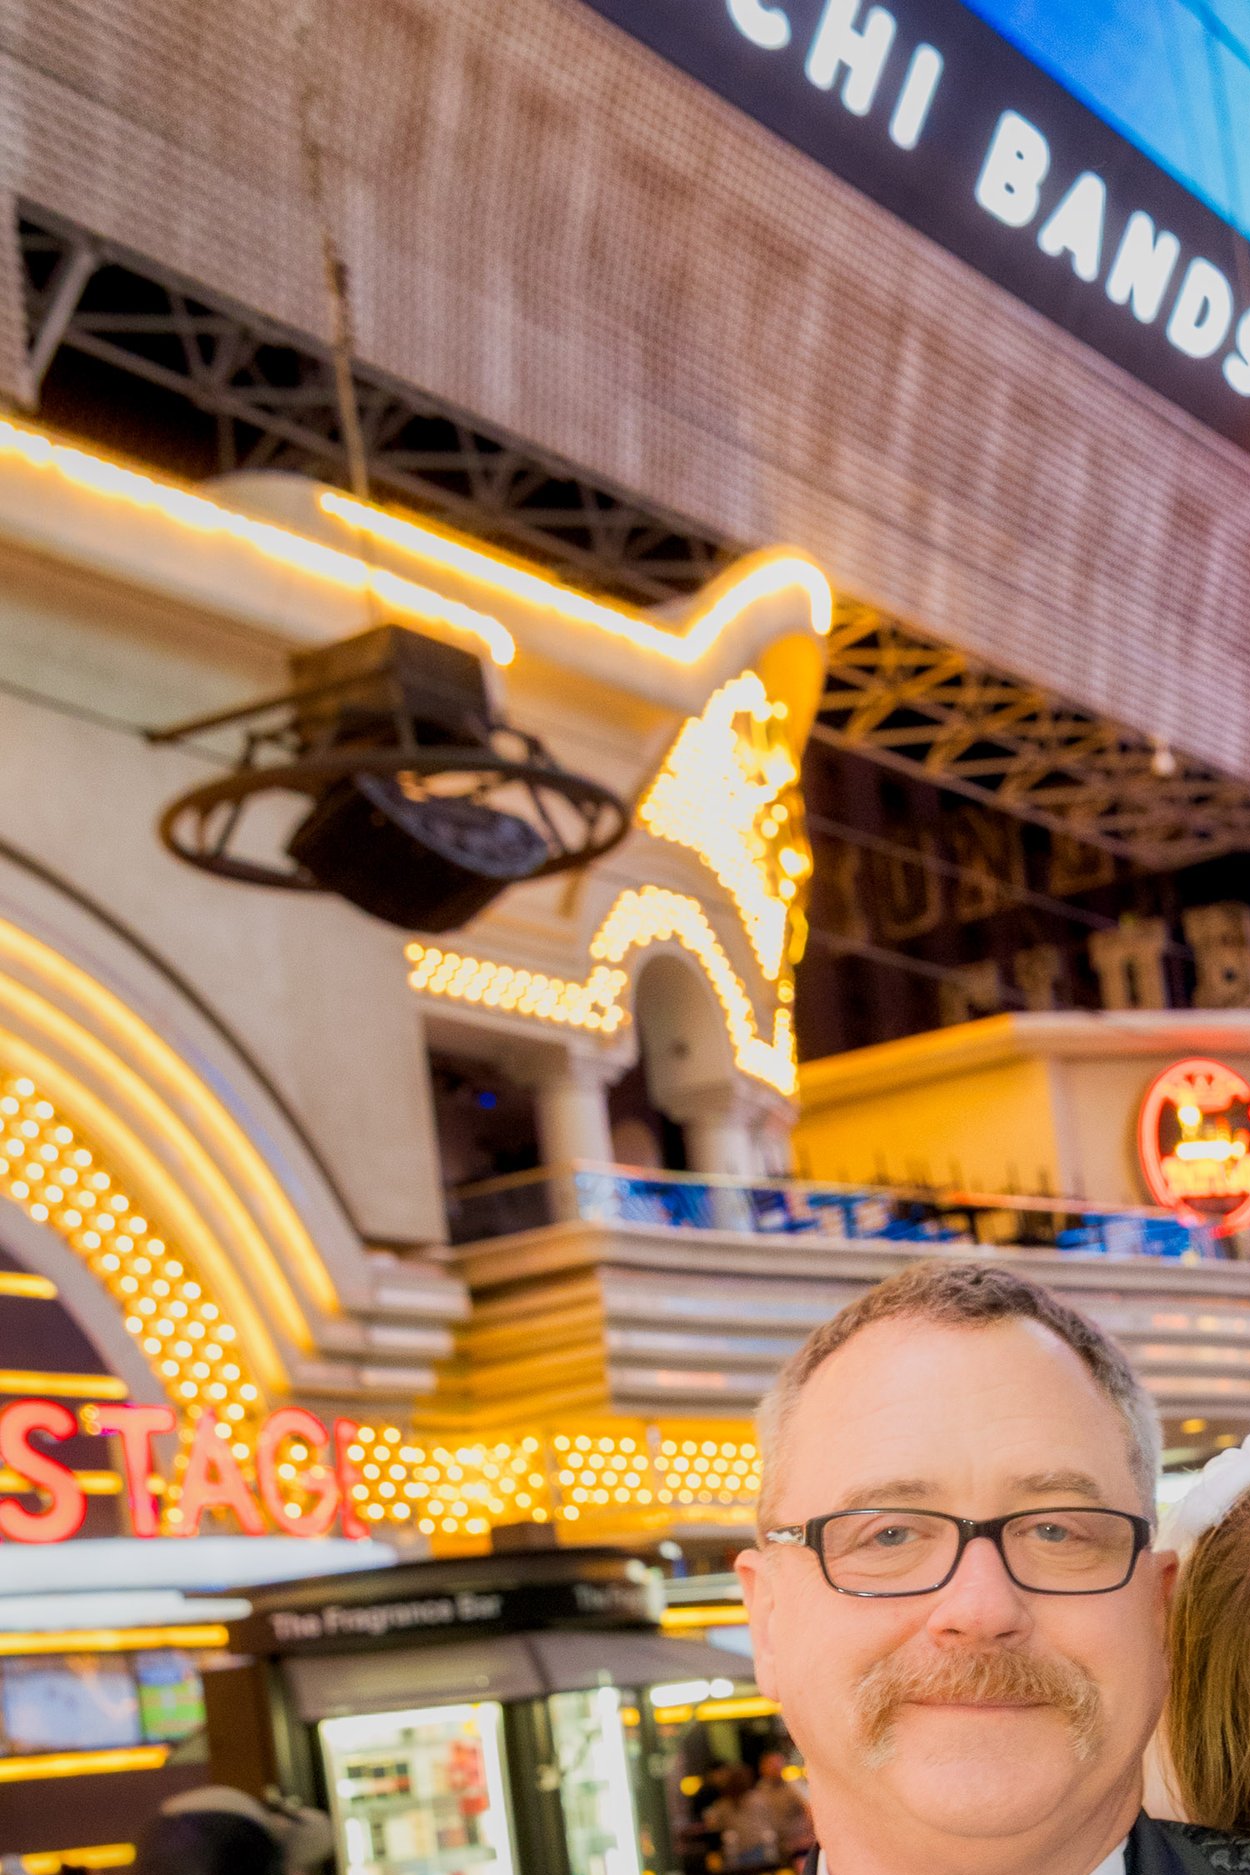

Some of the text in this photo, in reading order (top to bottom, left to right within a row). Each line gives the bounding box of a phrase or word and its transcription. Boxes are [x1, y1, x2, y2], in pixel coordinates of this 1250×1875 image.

[272, 1590, 503, 1642] The Fragrance Bar
